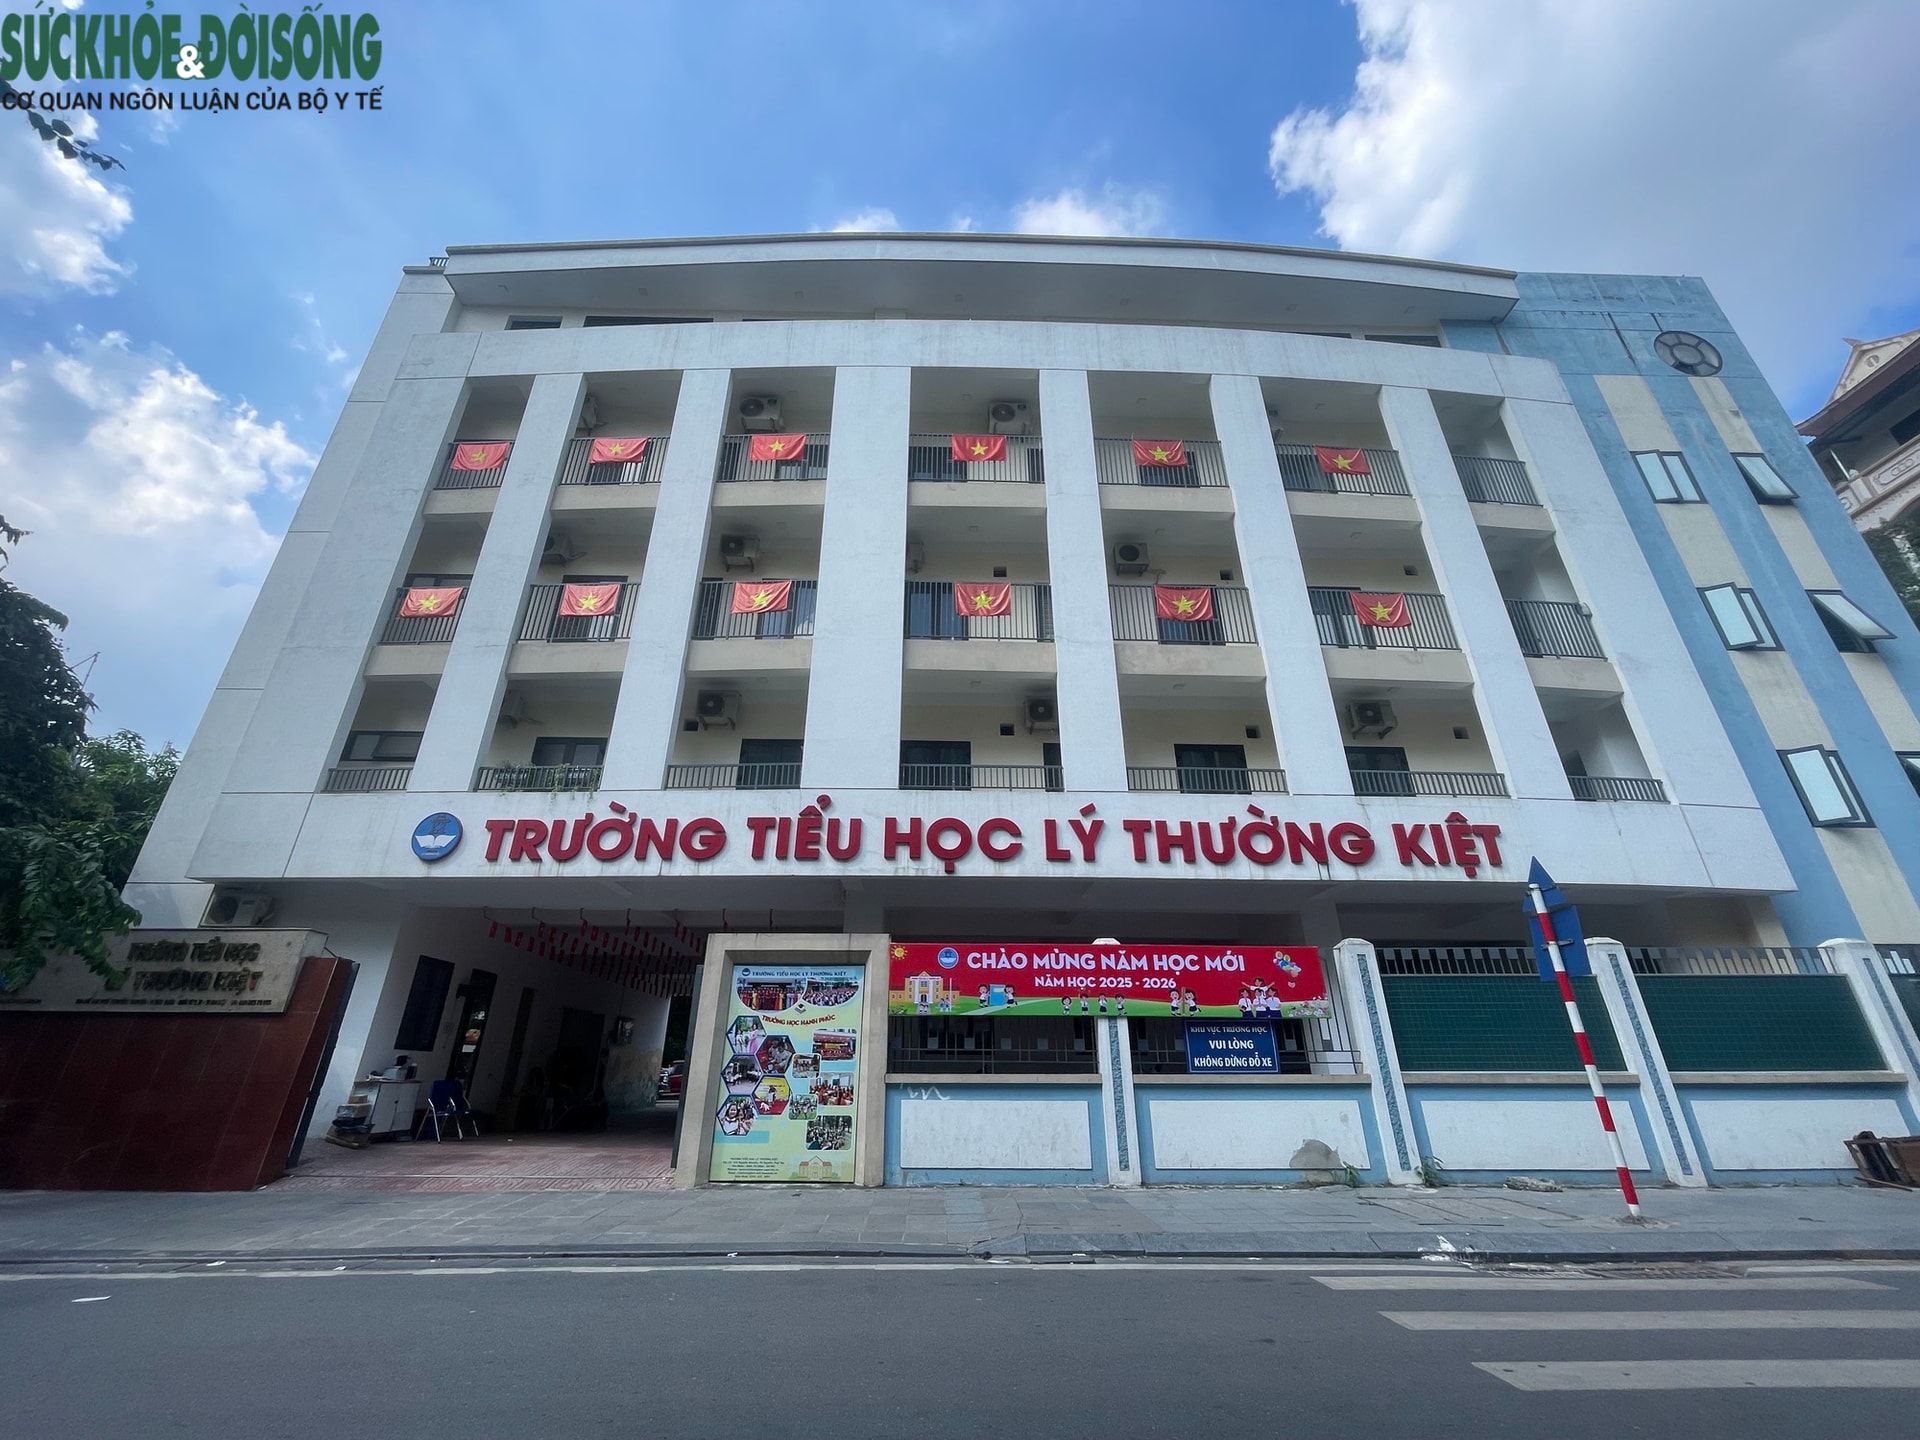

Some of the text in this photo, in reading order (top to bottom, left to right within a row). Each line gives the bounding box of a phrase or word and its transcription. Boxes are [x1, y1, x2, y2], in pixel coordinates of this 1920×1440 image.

[485, 794, 1503, 877] TRƯỜNG TIỂU HỌC LÝ THƯỜNG KIỆT
[967, 948, 1246, 976] CHÀO MỪNG NĂM HỌC MỚI
[1035, 974, 1064, 987] NĂM
[1067, 976, 1096, 990] HỌC
[1099, 977, 1133, 988] 2025
[1143, 978, 1177, 988] 2026
[1207, 1026, 1221, 1035] VỰC
[1252, 1026, 1267, 1035] HỌC
[1209, 1037, 1254, 1049] VUI LÒNG
[1194, 1051, 1272, 1067] KHÔNG DỪNG ĐỖ XE
